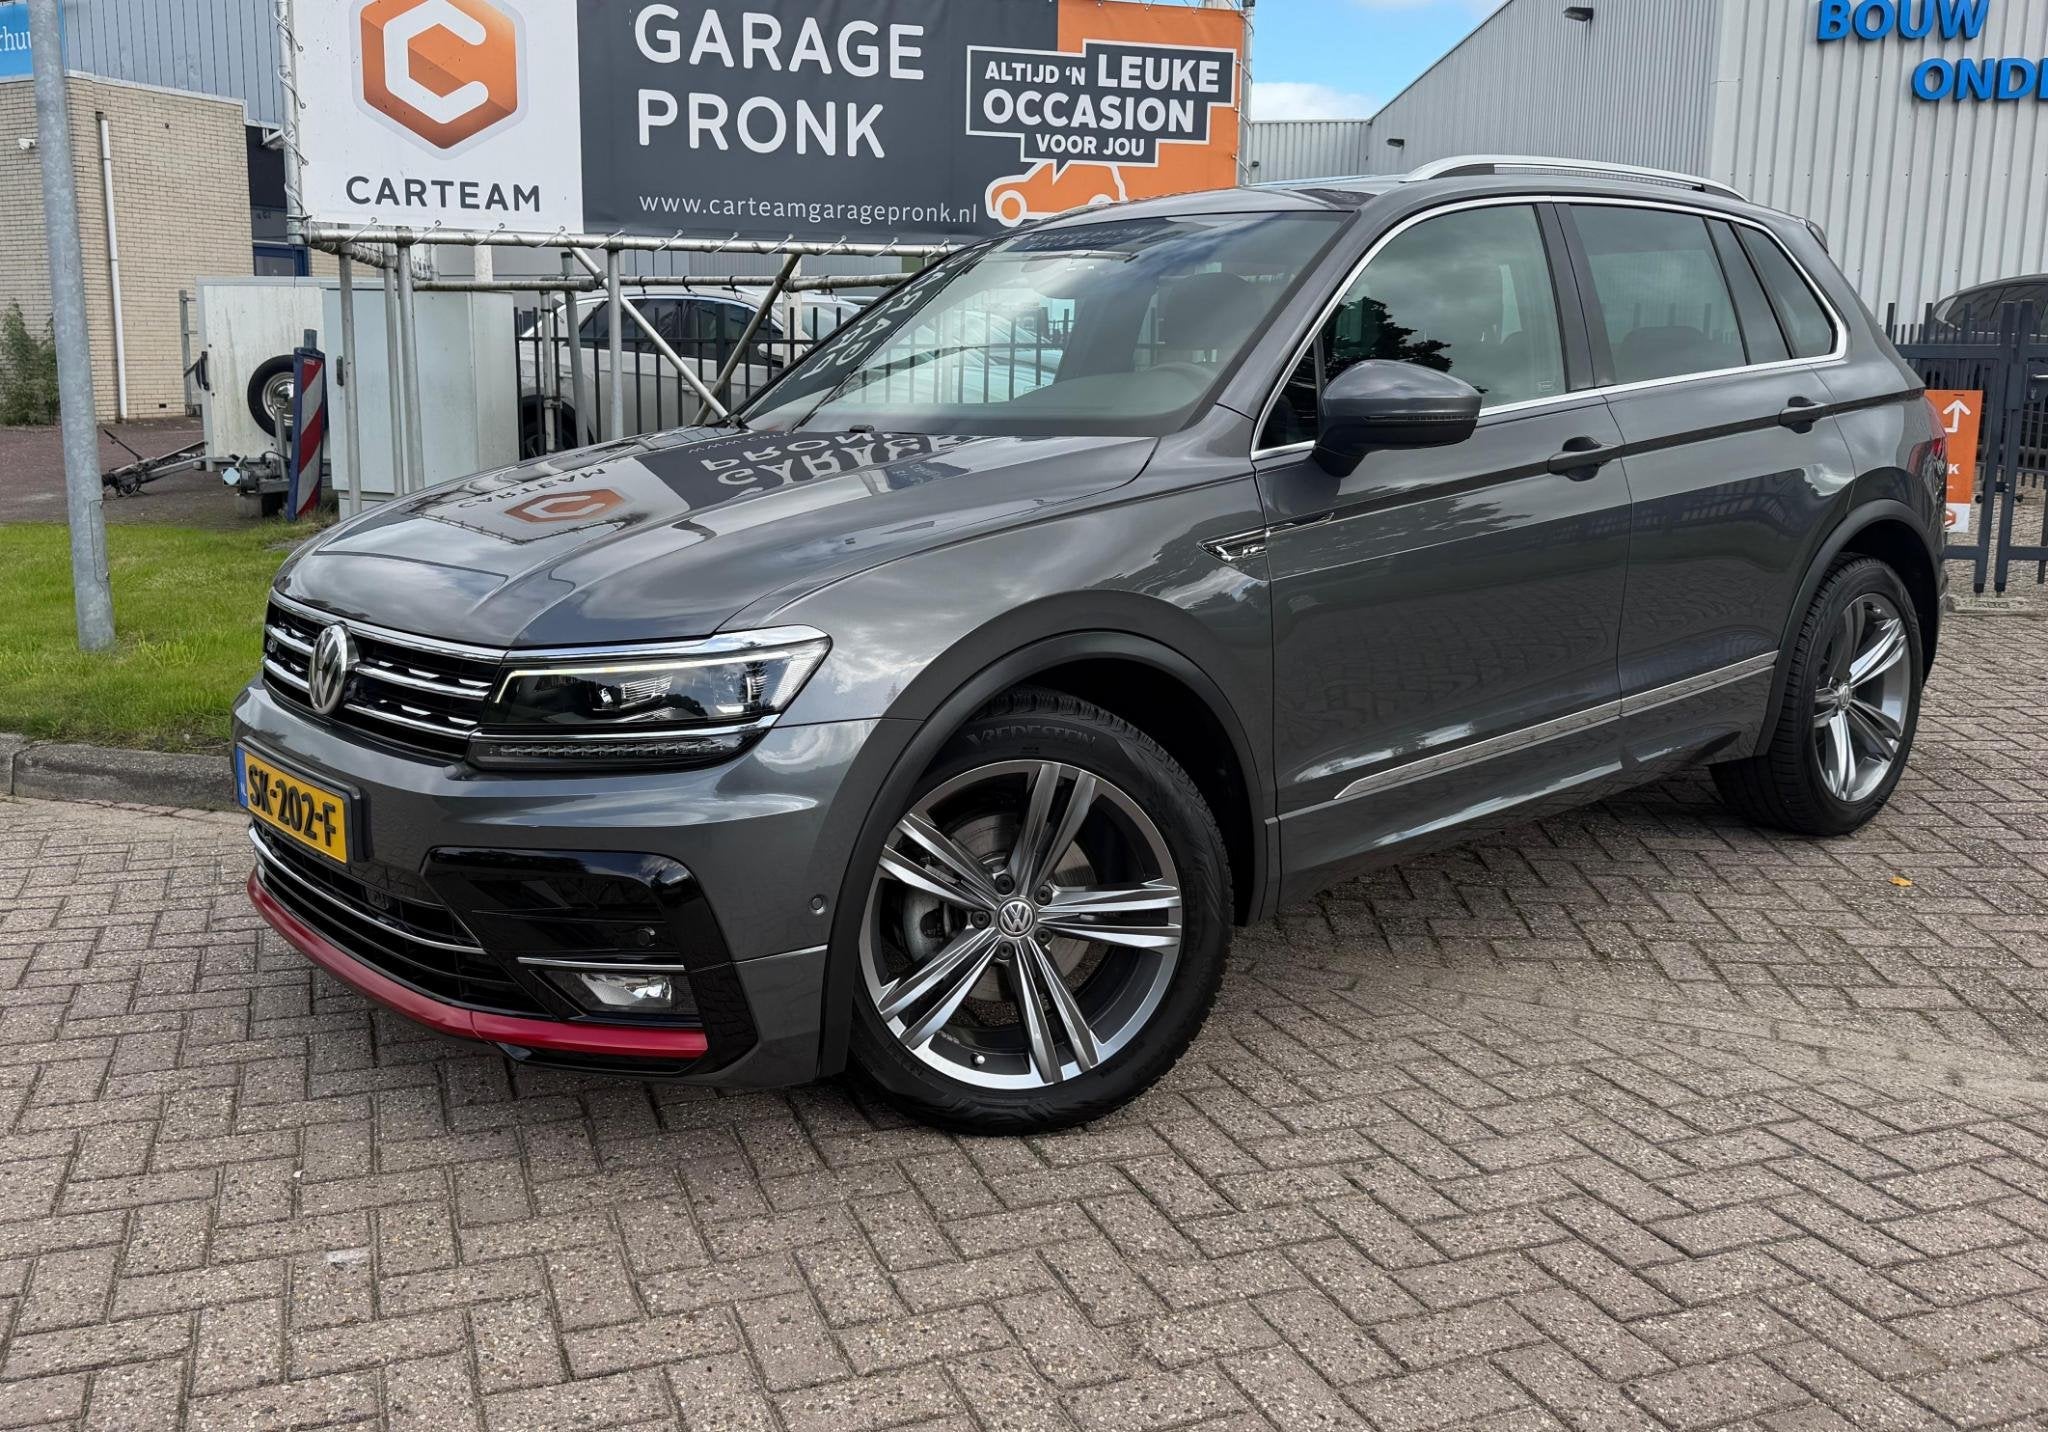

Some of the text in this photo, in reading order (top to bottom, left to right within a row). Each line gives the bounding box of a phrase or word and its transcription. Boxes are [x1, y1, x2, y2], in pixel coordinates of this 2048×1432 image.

[1817, 0, 1989, 41] BOUW
[635, 4, 924, 80] GARAGE
[984, 61, 1060, 84] ALTIJD
[1097, 54, 1219, 93] LEUKE
[638, 89, 885, 158] PRONK
[983, 88, 1194, 133] OCCASION
[1036, 134, 1145, 156] VOOR JOU
[346, 176, 540, 212] CARTEAM
[639, 195, 977, 225] www.carteamgaragepronk.nl
[249, 764, 337, 848] SK-202-F
